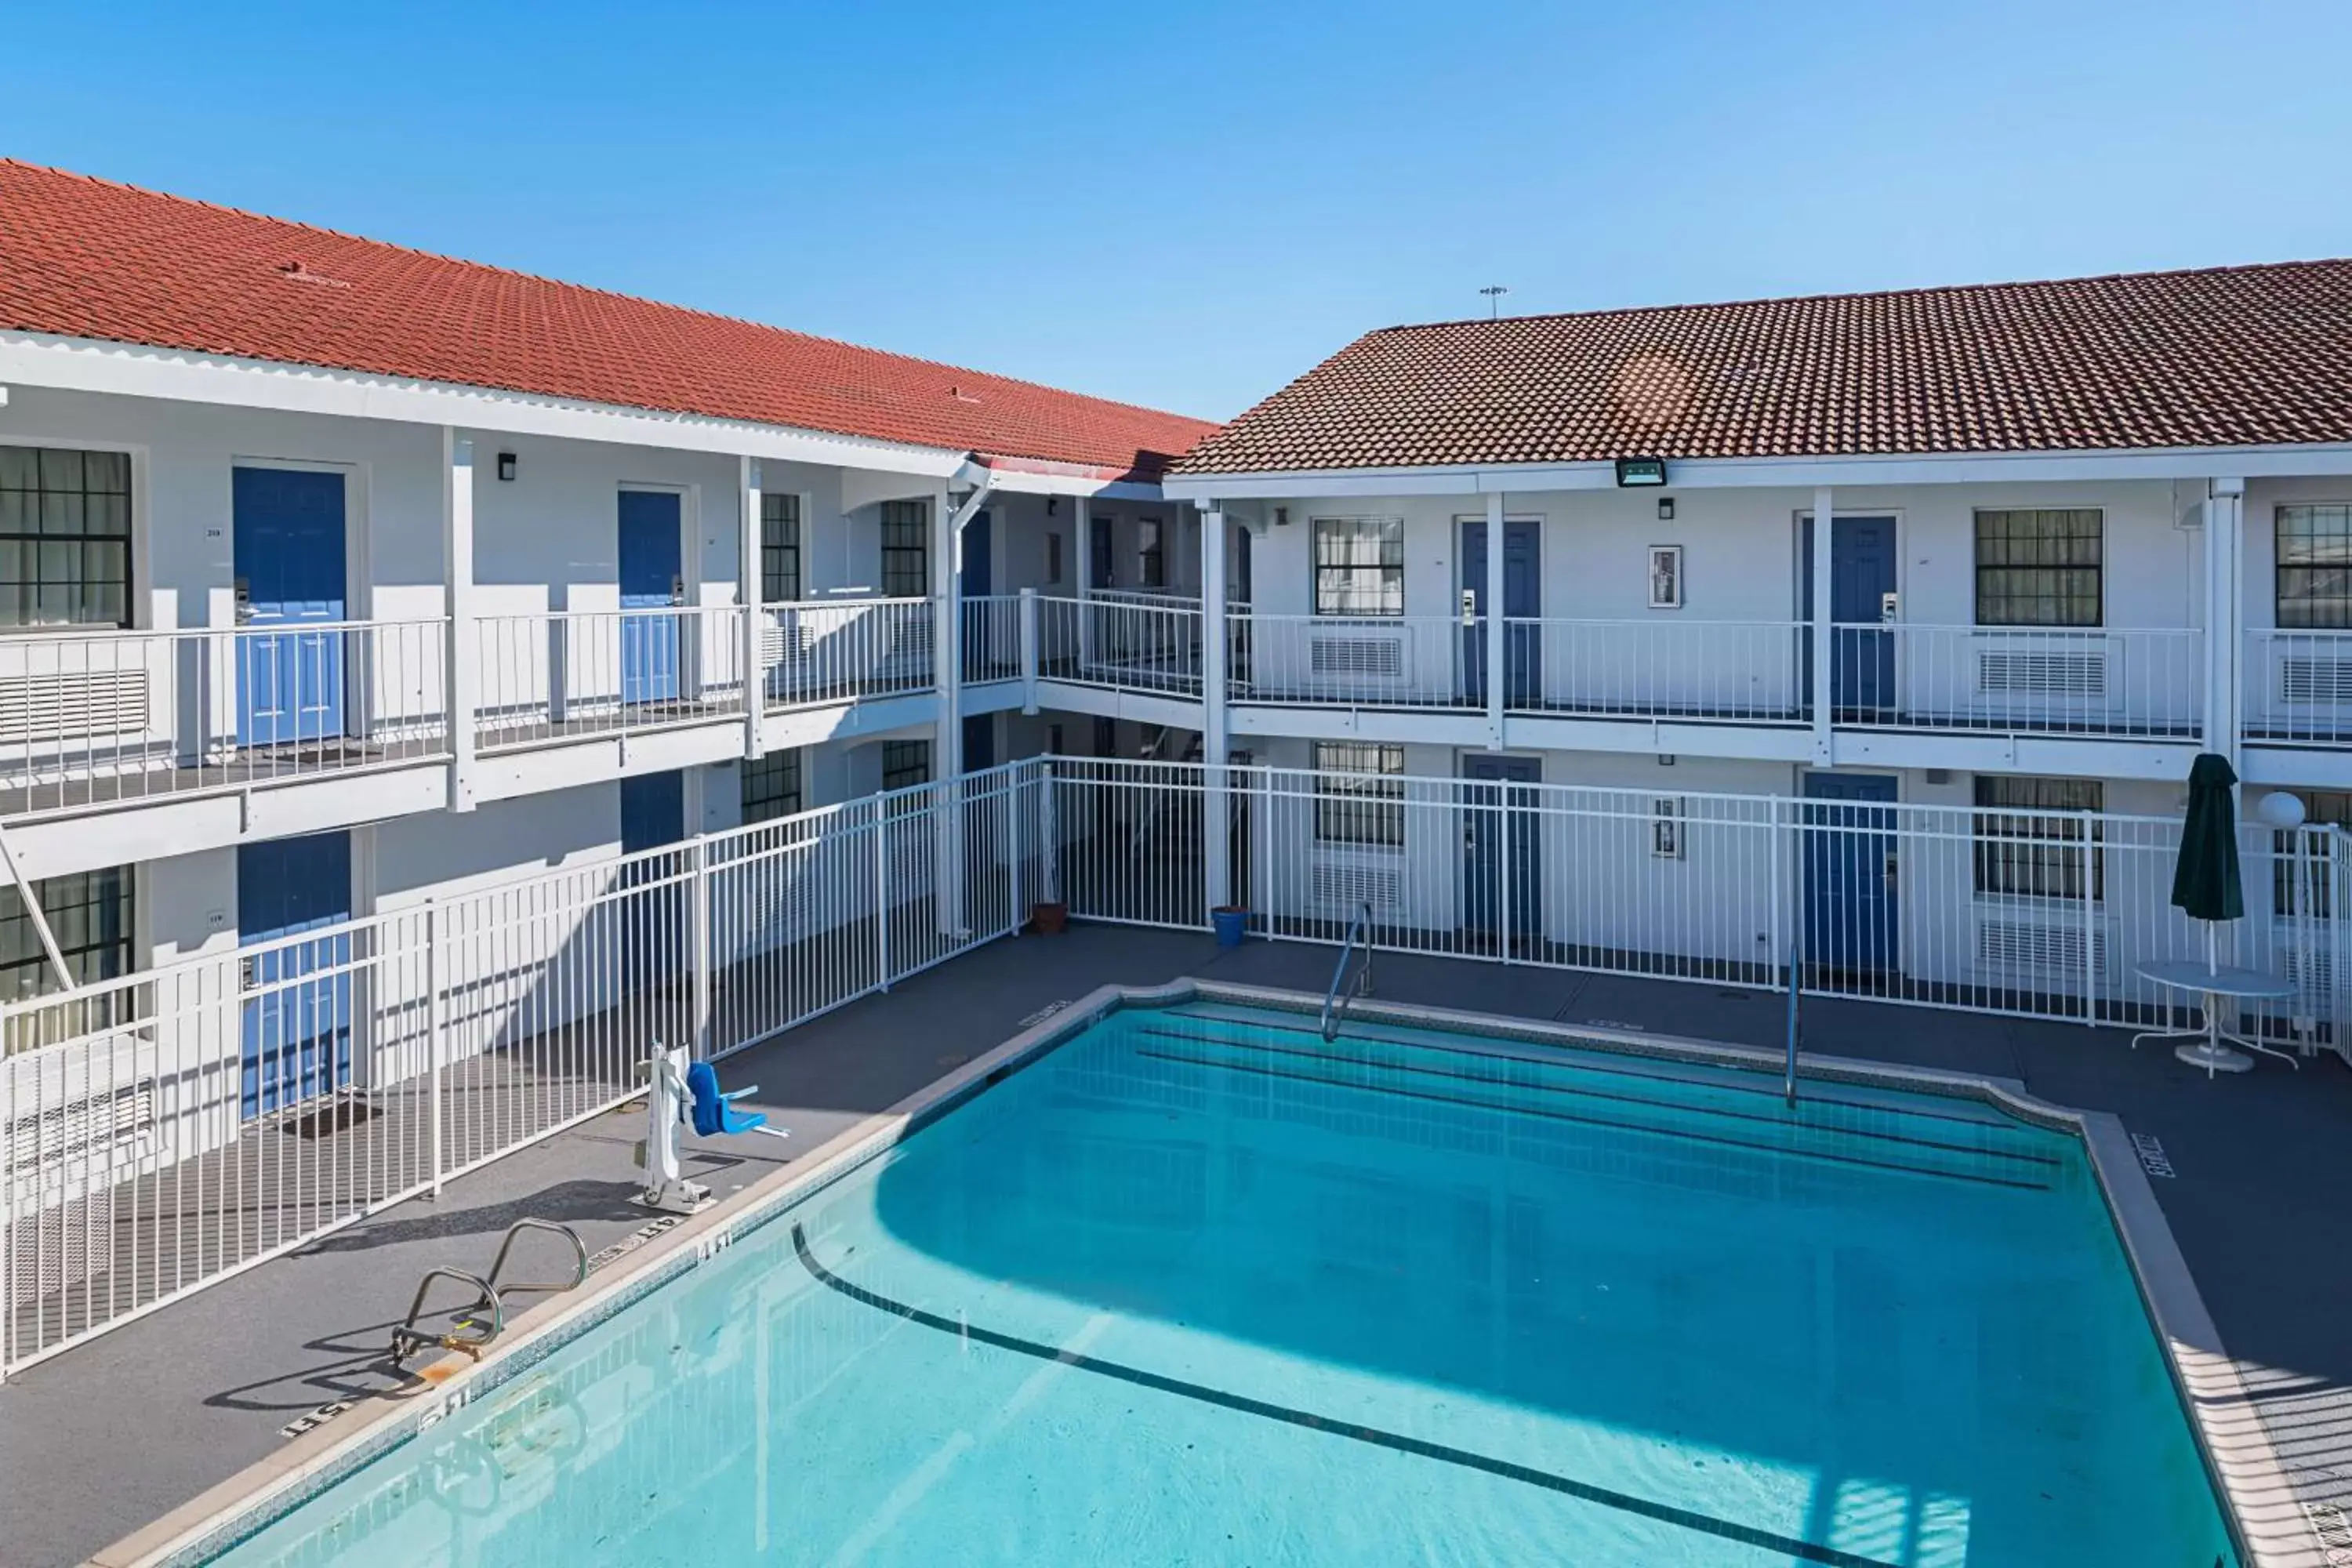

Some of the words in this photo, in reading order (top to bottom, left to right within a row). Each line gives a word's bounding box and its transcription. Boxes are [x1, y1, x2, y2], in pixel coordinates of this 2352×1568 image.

[637, 1226, 662, 1239] FT
[657, 1218, 675, 1228] 4
[715, 1229, 730, 1254] FT
[318, 1402, 347, 1417] 5
[445, 1385, 469, 1417] FT
[283, 1414, 322, 1438] FT
